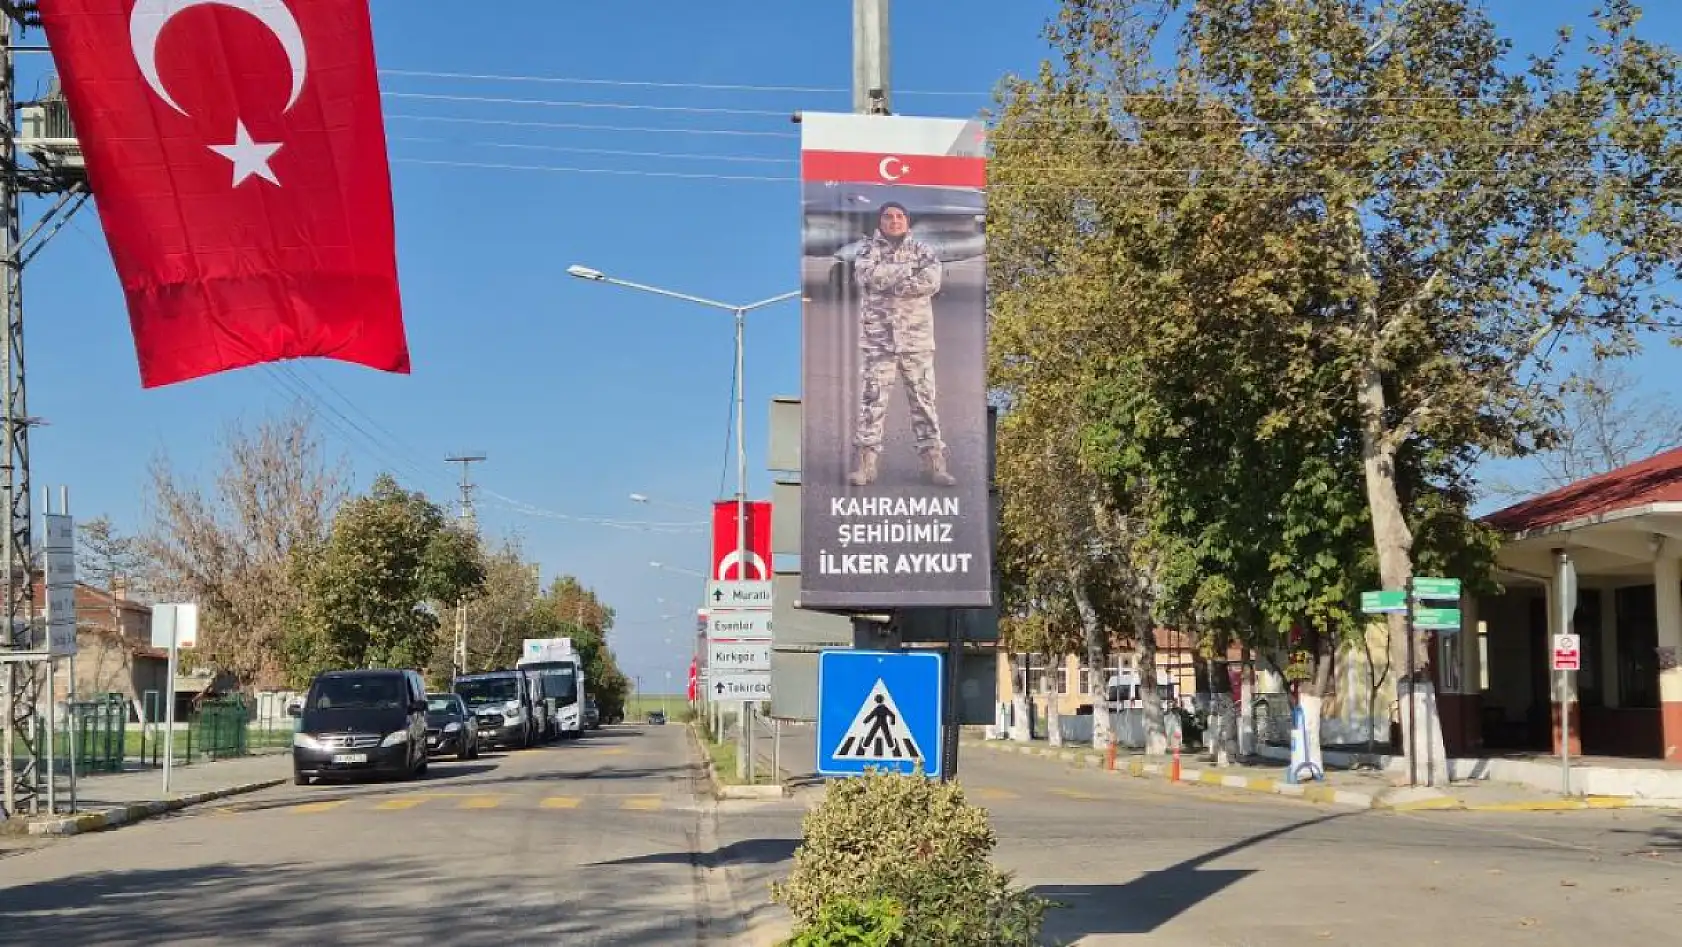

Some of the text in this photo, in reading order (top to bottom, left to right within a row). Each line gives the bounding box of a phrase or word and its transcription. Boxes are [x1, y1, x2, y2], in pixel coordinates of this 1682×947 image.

[831, 496, 959, 516] KAHRAMAN
[838, 518, 954, 547] ŞEHİDİMİZ
[819, 549, 973, 575] İLKER AYKUT
